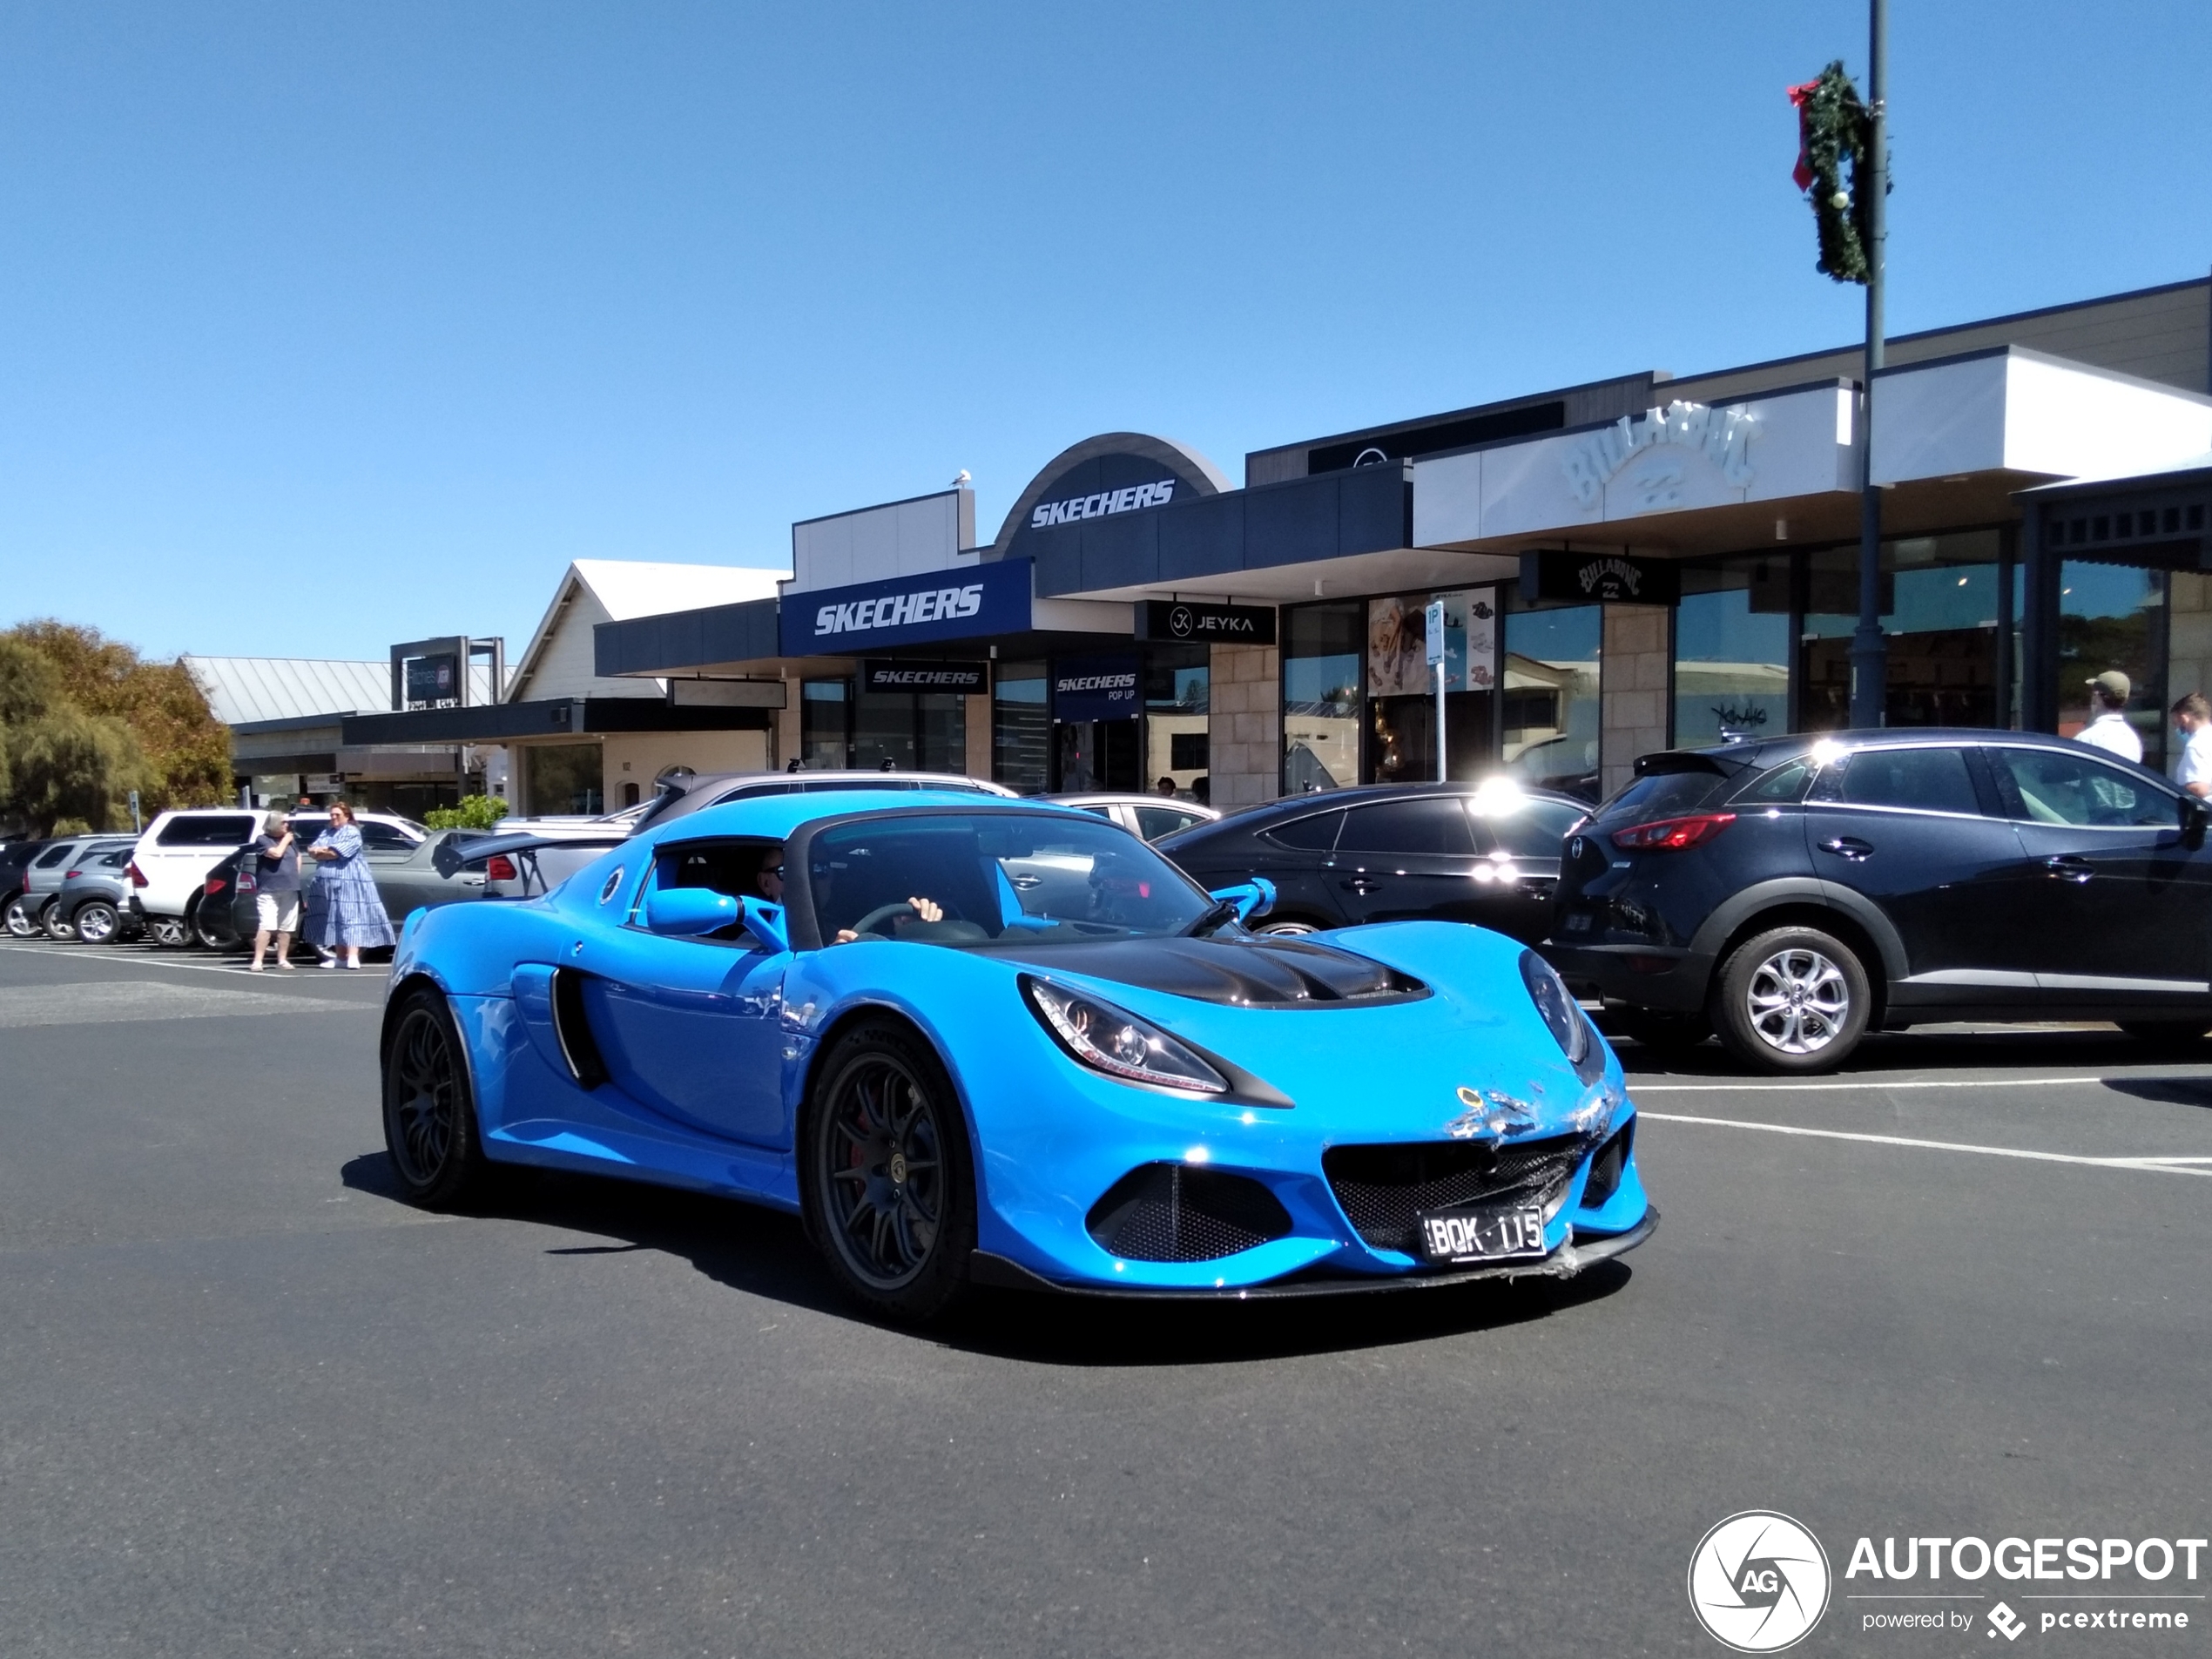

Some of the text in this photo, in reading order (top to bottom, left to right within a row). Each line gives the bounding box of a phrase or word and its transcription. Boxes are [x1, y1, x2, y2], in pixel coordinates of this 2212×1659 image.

[1031, 479, 1175, 529] SKECHERS
[1578, 558, 1642, 596] BILLABONG
[814, 583, 984, 636] SKECHERS
[1428, 609, 1439, 624] 1P
[1197, 616, 1254, 631] JEYKA
[873, 671, 980, 685] SKECHERS
[1057, 674, 1136, 692] SKECHERS
[1109, 690, 1135, 701] POP UP
